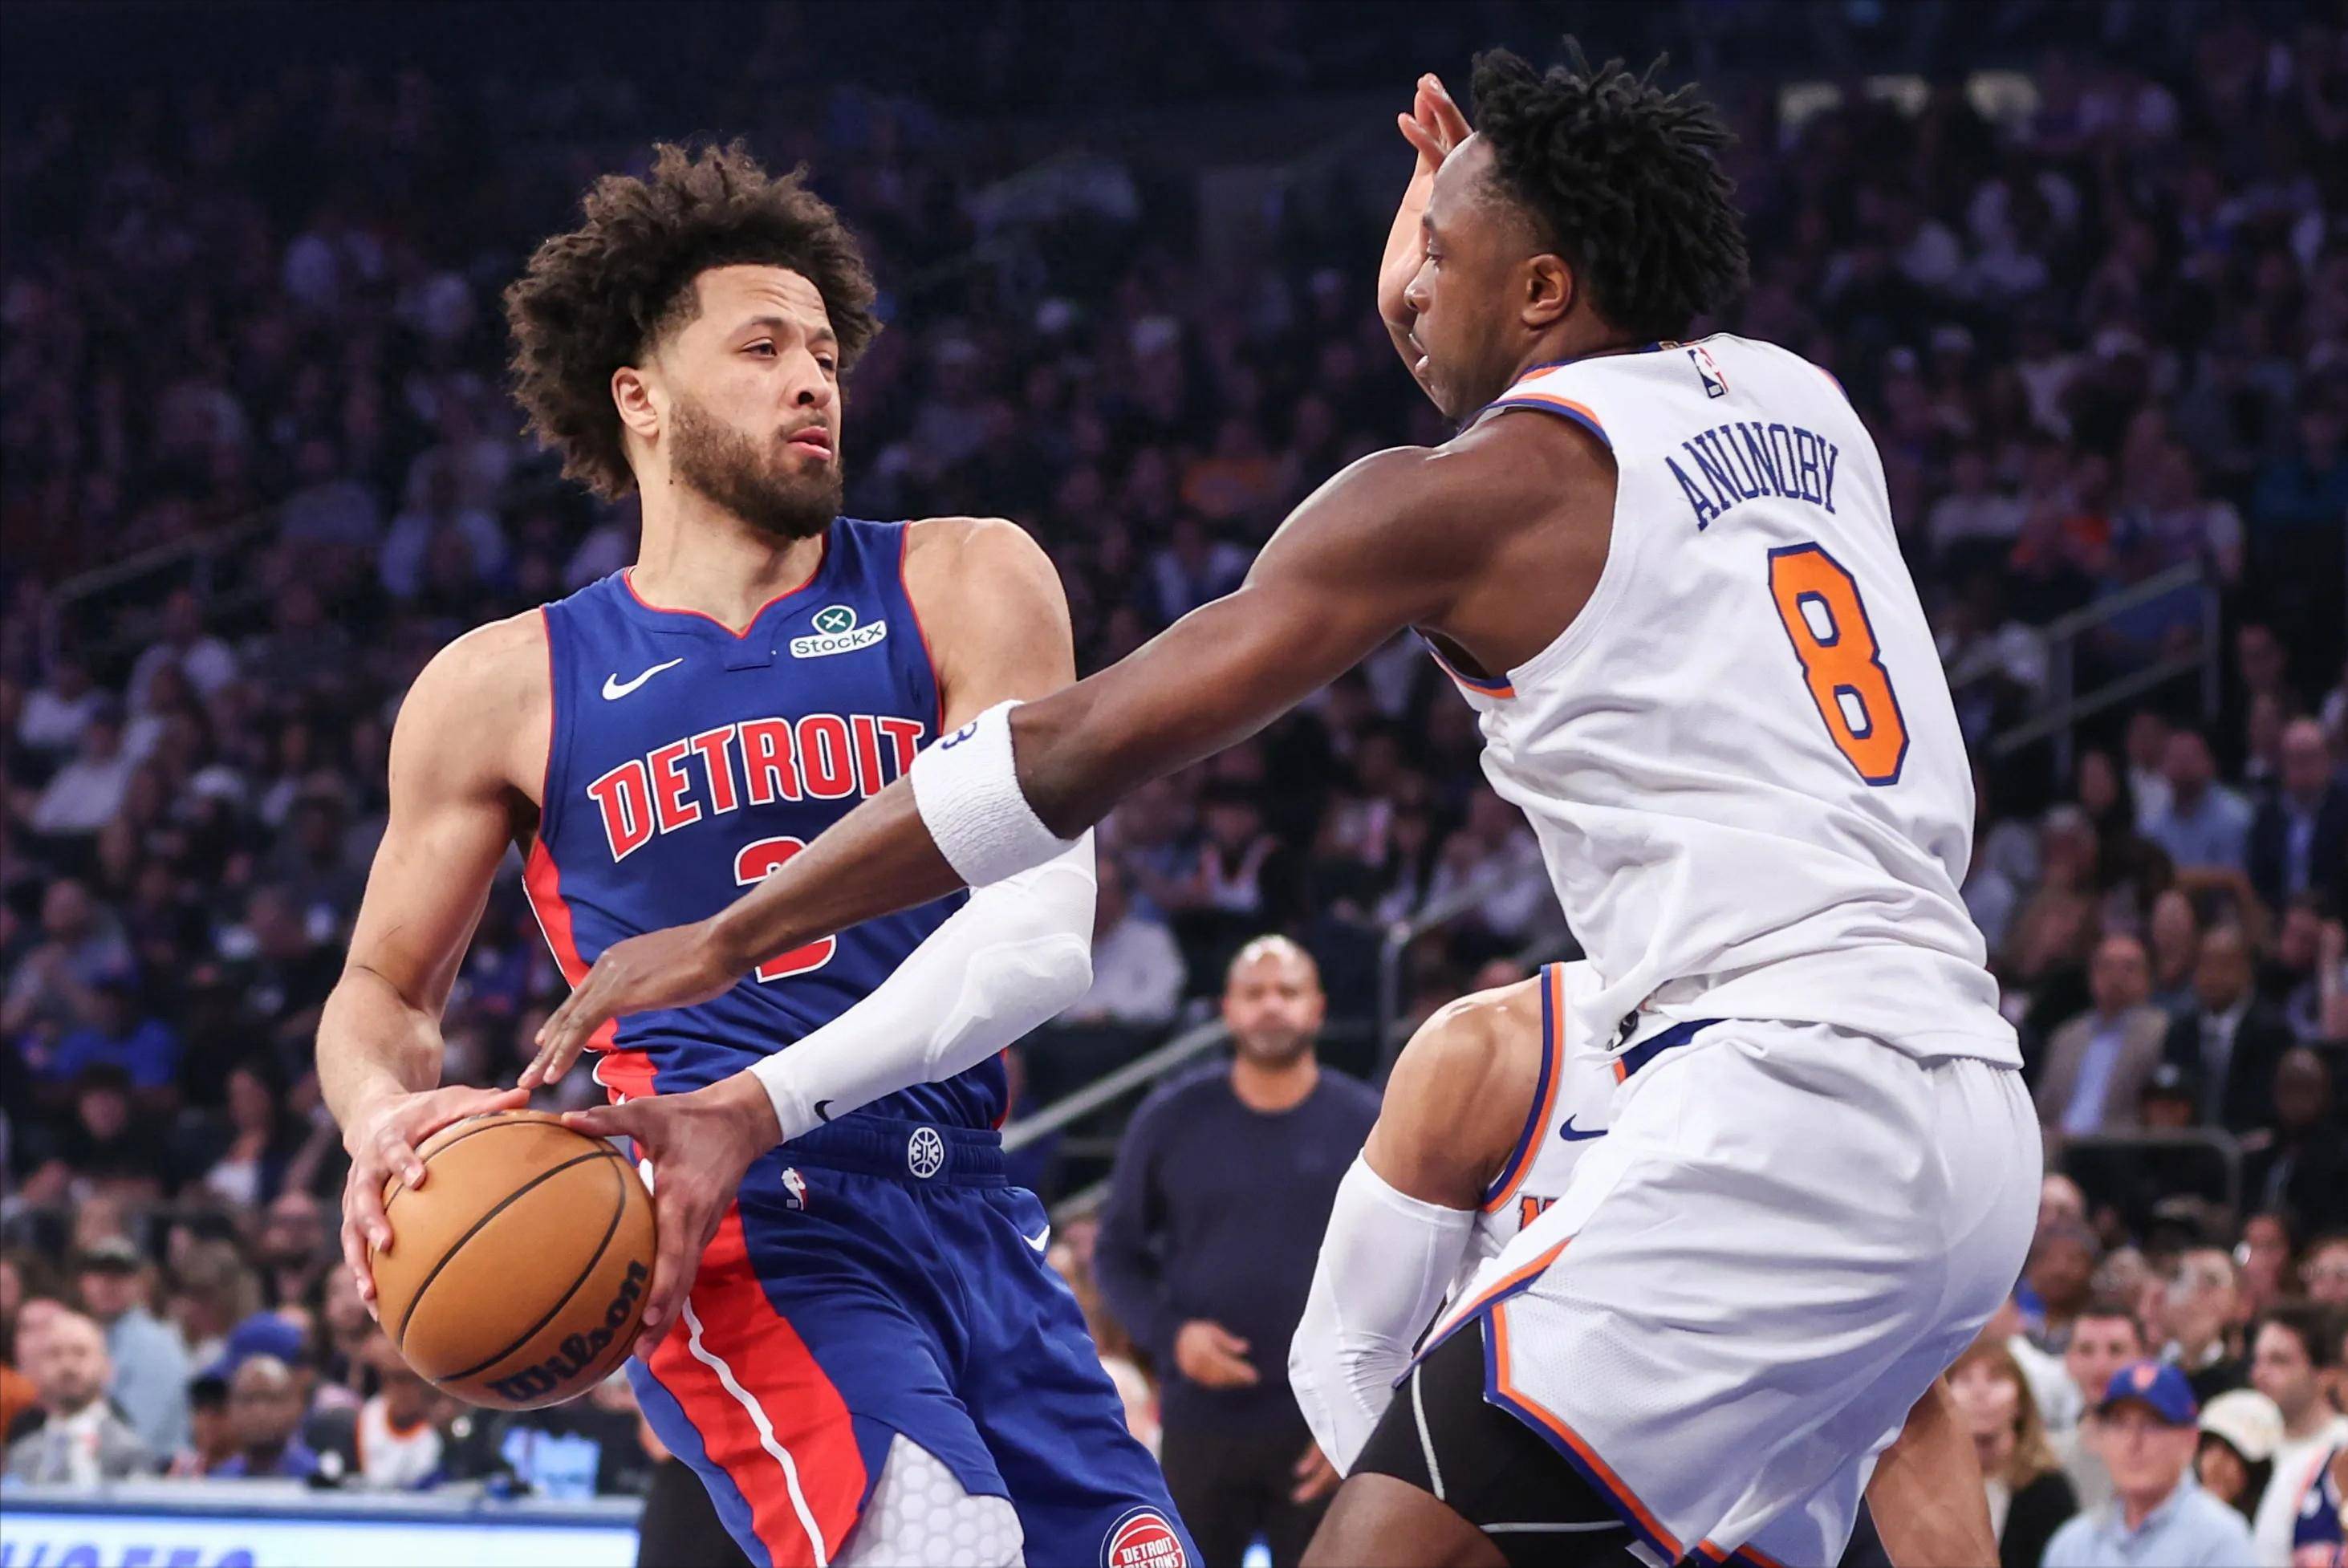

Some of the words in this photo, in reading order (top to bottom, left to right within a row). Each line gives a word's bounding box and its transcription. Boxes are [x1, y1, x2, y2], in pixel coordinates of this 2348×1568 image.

[1665, 421, 1838, 531] ANUNOBY
[794, 624, 883, 654] StockX
[1768, 542, 1909, 786] 8
[587, 714, 924, 863] DETROIT
[485, 1259, 648, 1401] Wilson
[1120, 1537, 1172, 1564] DETROIT
